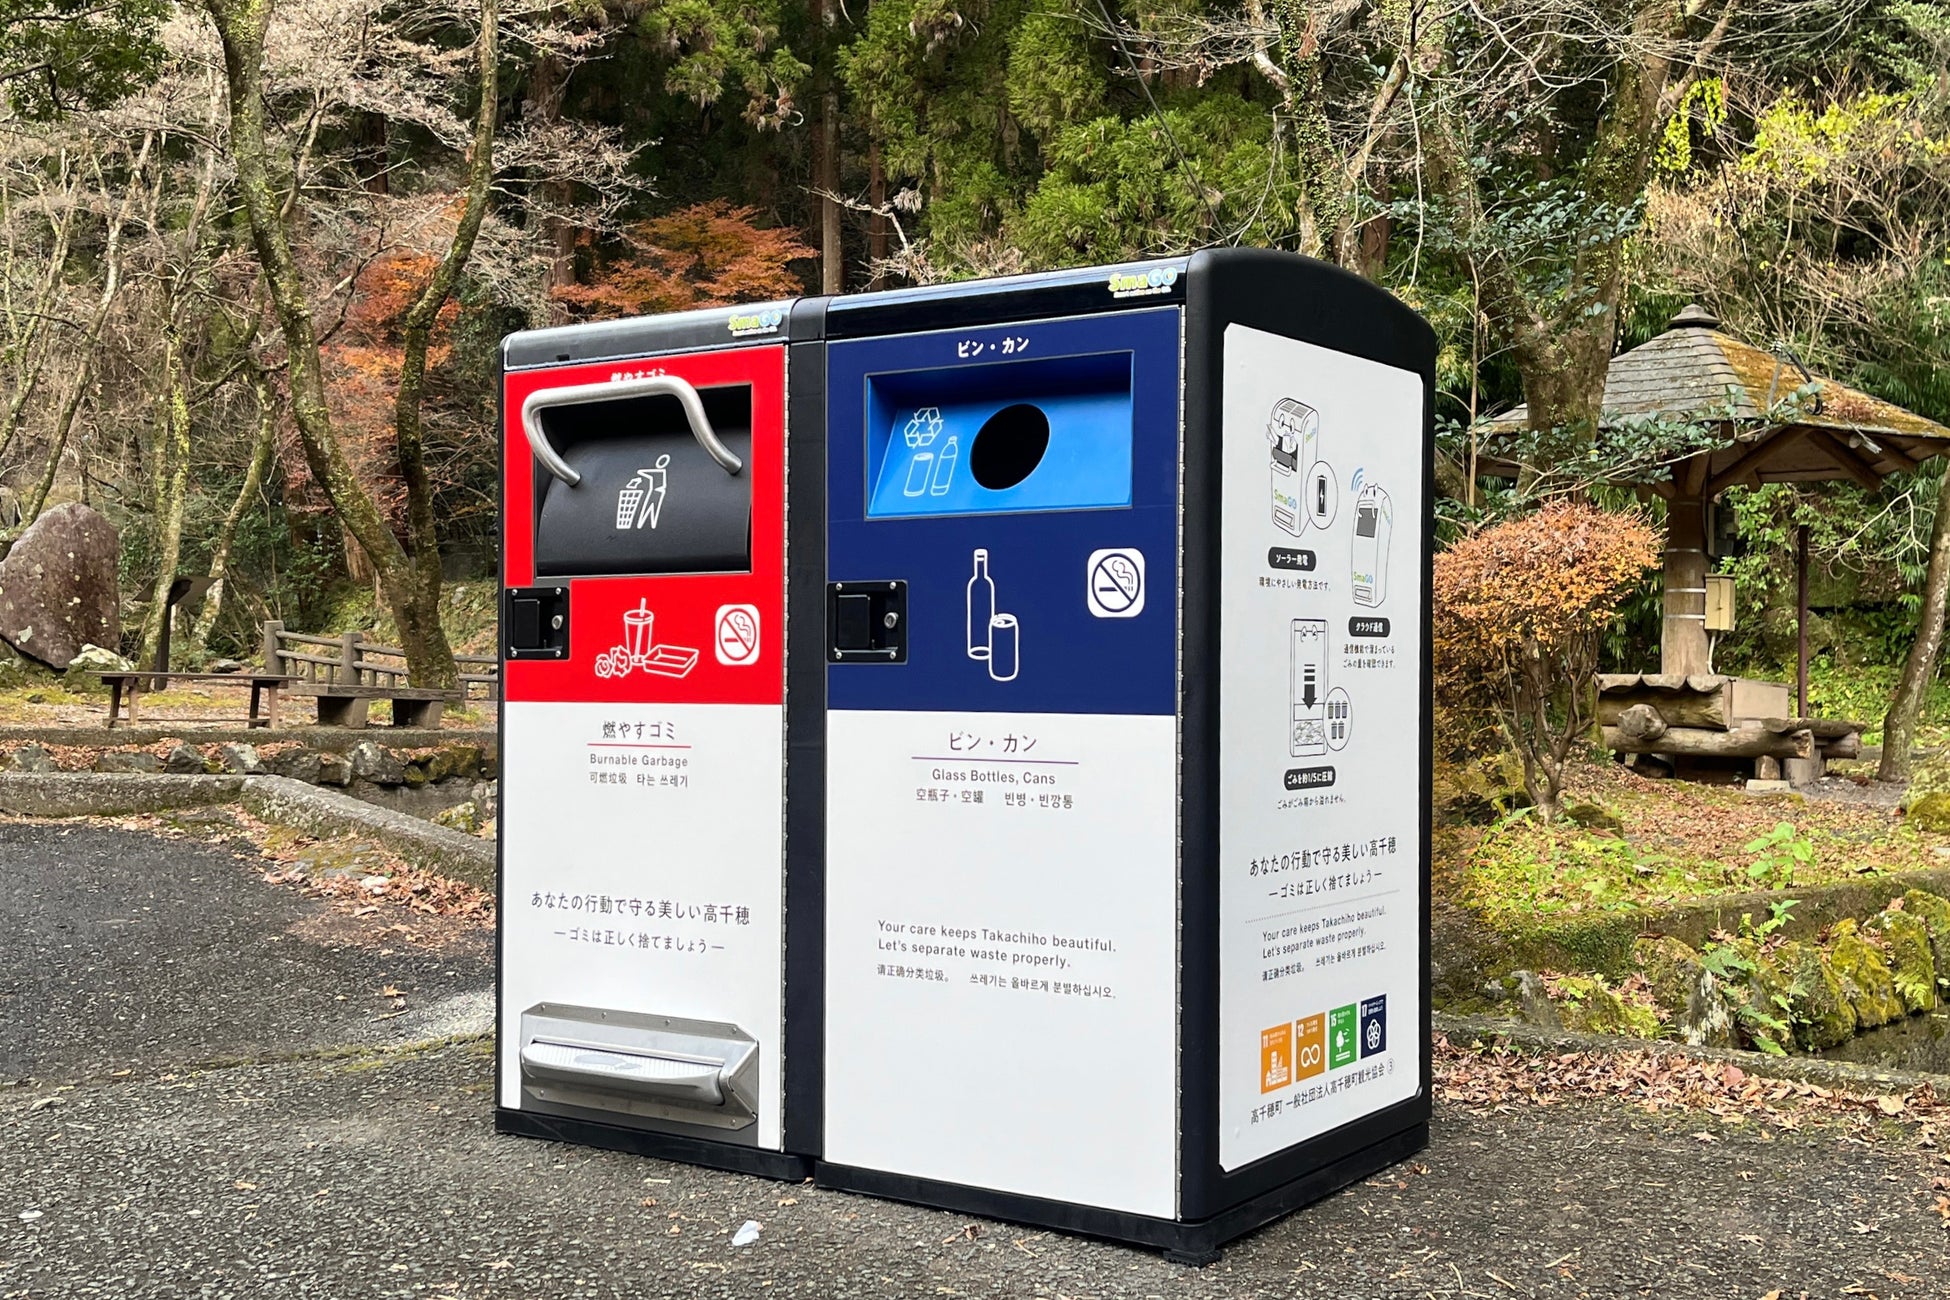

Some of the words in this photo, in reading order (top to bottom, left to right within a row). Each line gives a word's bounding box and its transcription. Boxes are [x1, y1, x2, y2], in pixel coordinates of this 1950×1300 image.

[1108, 267, 1178, 292] SmaGO
[957, 337, 1030, 358] ビン・カン
[602, 720, 675, 740] 燃やすゴミ
[949, 731, 1037, 753] ビン・カン
[590, 753, 638, 766] Burnable
[641, 755, 689, 769] Garbage
[589, 771, 628, 785] 可燃垃圾
[636, 773, 656, 787] 타는
[659, 774, 688, 788] 쓰레기
[932, 768, 967, 782] Glass
[970, 769, 1020, 786] Bottles,
[1022, 771, 1056, 785] Cans
[1250, 836, 1397, 878] あなたの行動で守る美しい高千穂
[531, 890, 751, 926] あなたの行動で守る美しい高千穂
[877, 919, 905, 933] Your
[909, 923, 937, 936] care
[941, 925, 977, 941] keeps
[982, 928, 1048, 947] Takachiho
[1052, 934, 1117, 953] beautiful.
[1262, 931, 1280, 943] Your
[1281, 926, 1298, 938] care
[1299, 921, 1320, 935] keeps
[1321, 913, 1355, 929] Takachiho
[878, 938, 907, 953] Let's
[911, 942, 966, 959] separate
[970, 949, 1008, 963] waste
[1012, 953, 1072, 970] properly.
[1262, 945, 1281, 959] Let's
[1282, 937, 1314, 955] separate
[1315, 932, 1336, 946] waste
[969, 973, 1007, 989] 쓰레기는
[1011, 977, 1050, 993] 올바르게
[1251, 1099, 1284, 1125] 高千穂町
